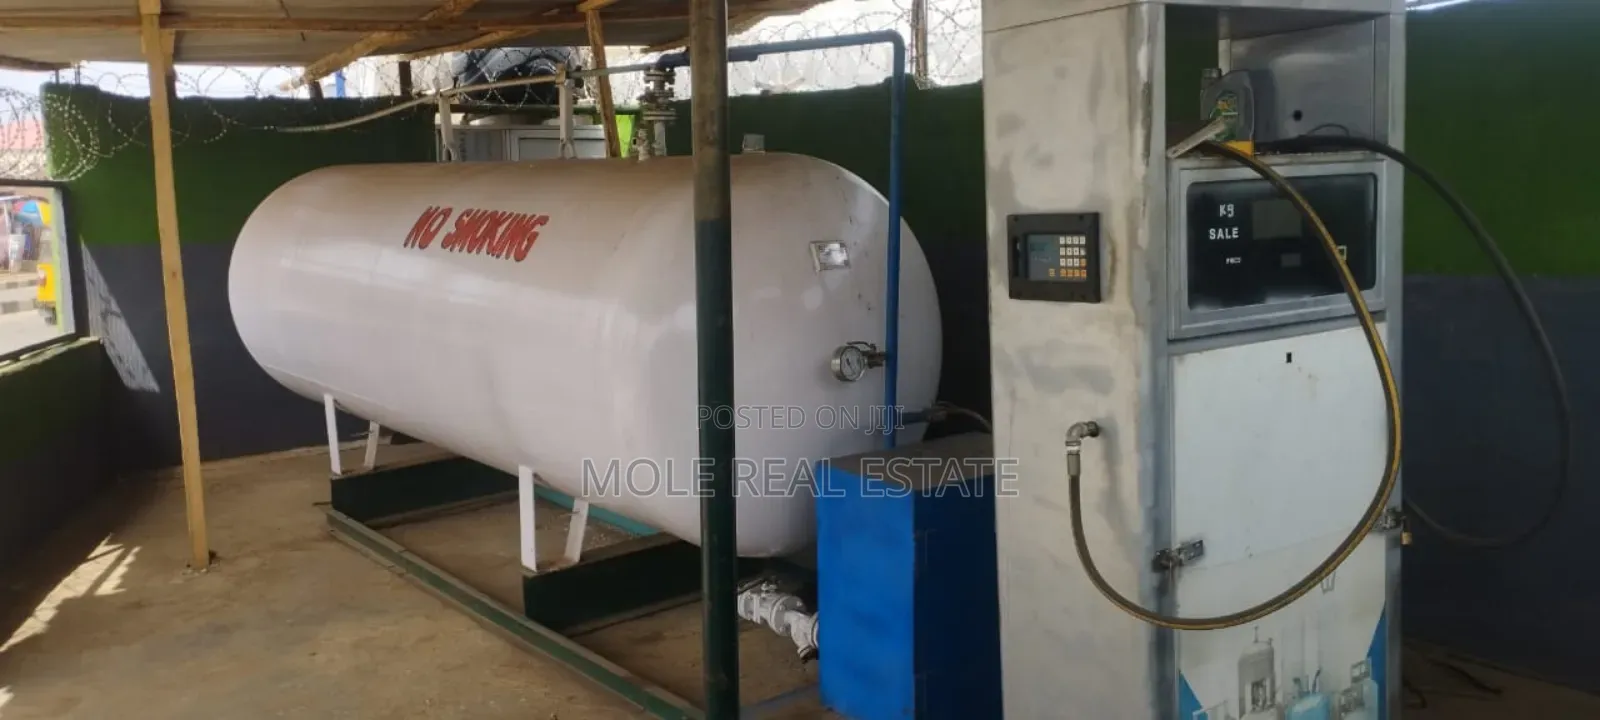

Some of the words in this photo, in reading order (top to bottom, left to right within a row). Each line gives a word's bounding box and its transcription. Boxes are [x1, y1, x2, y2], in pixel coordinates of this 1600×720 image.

[403, 205, 453, 250] NO
[441, 208, 550, 262] SMOKING
[1209, 226, 1239, 240] SALE
